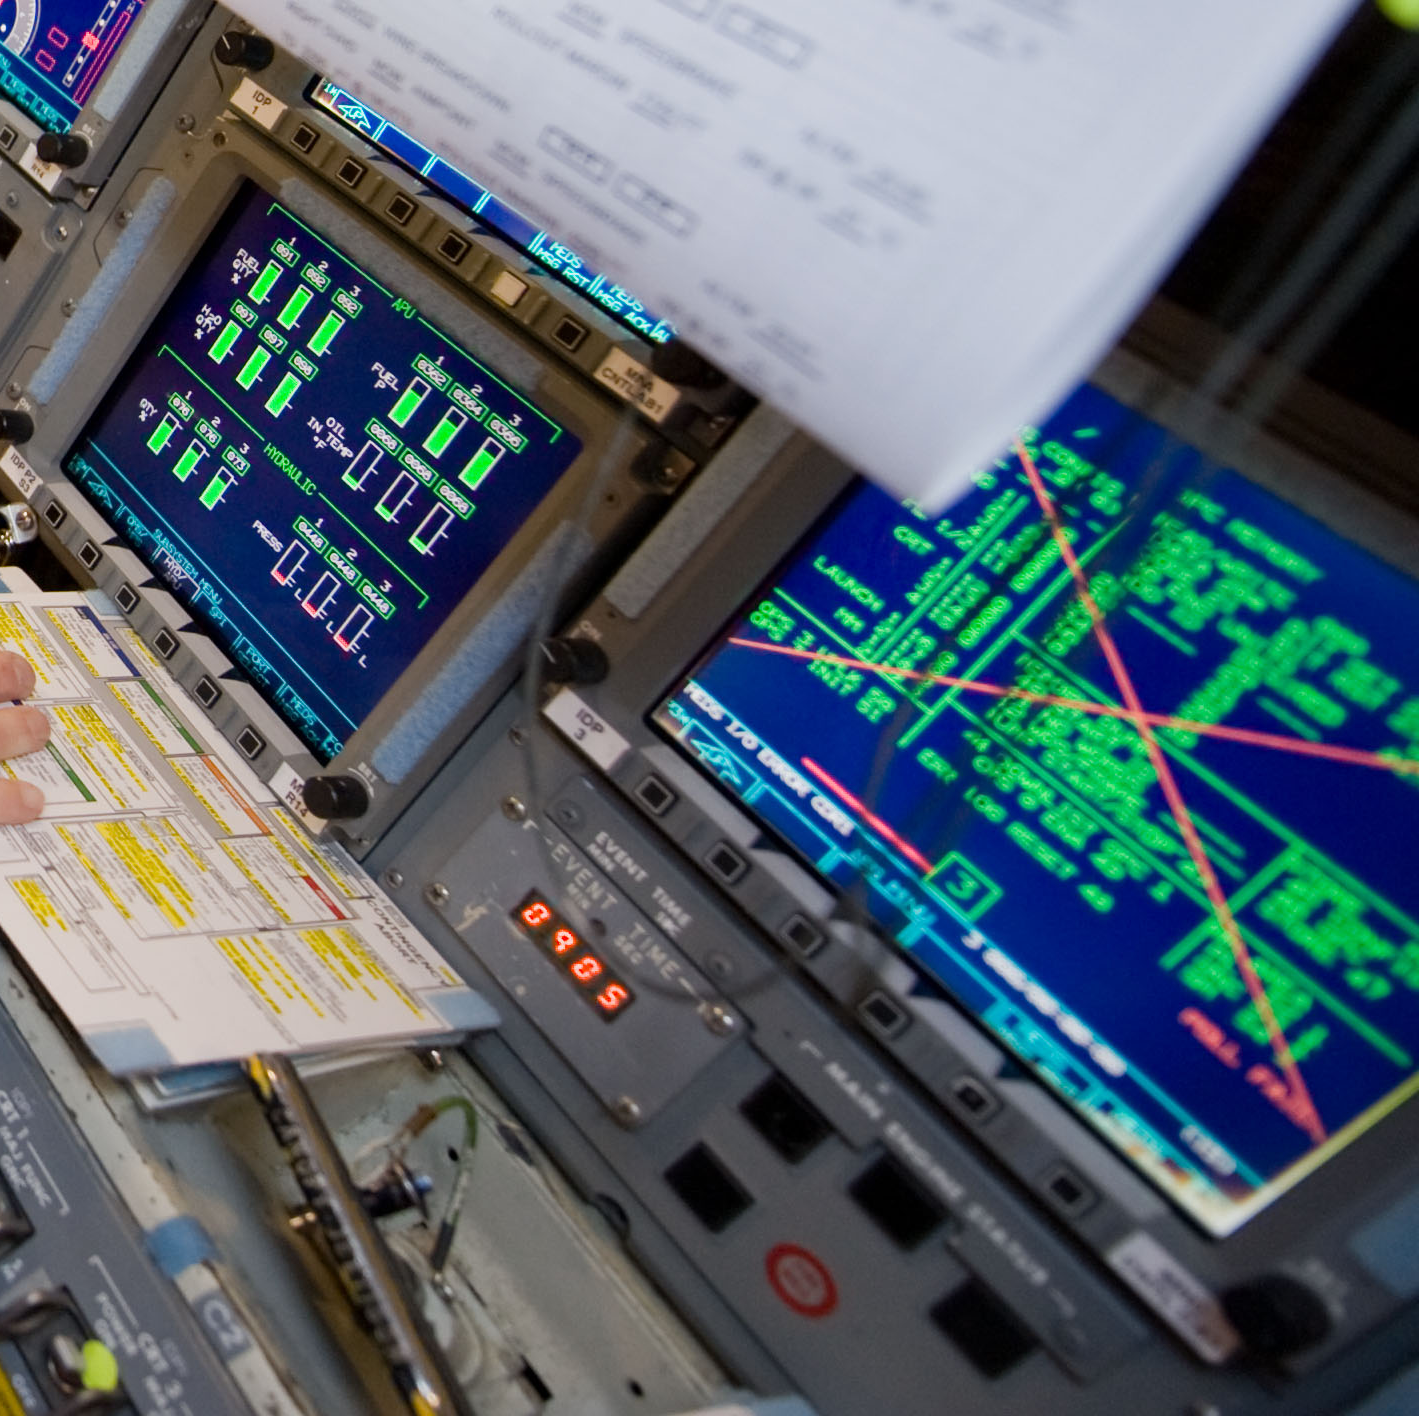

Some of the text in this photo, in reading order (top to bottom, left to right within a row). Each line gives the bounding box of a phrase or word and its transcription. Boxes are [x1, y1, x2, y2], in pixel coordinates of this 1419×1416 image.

[252, 90, 272, 106] IDP
[252, 106, 258, 114] 1
[289, 237, 297, 246] 1
[236, 248, 259, 273] FUEL
[549, 241, 585, 268] MEDS
[232, 259, 252, 278] QTY
[319, 261, 329, 272] 2
[563, 267, 591, 288] RST
[350, 285, 362, 297] 3
[201, 304, 222, 326] H2O
[391, 298, 417, 319] APU
[195, 315, 216, 334] QTY
[623, 312, 653, 333] ACK
[436, 356, 445, 366] 1
[371, 362, 399, 391] FUEL
[373, 379, 386, 389] P
[185, 390, 193, 401] 1
[470, 384, 483, 397] 2
[139, 398, 158, 418] QTY
[211, 416, 222, 428] 2
[325, 416, 345, 440] OIL
[509, 414, 523, 427] 3
[307, 416, 353, 458] IN TEMP
[239, 442, 251, 455] 3
[10, 452, 36, 484] IDP P2
[263, 442, 317, 496] HYDRAULIC
[18, 478, 30, 493] S3
[315, 518, 324, 528] 1
[252, 520, 284, 553] PRESS
[346, 548, 358, 561] 2
[154, 528, 223, 605] SUBSYSTEM MENU
[164, 555, 188, 580] HYD/
[380, 580, 393, 593] 3
[813, 554, 886, 613] LAUNCH
[209, 606, 226, 627] SPI
[246, 646, 271, 673] PORT
[290, 696, 316, 725] MEDS
[575, 708, 605, 733] IDP
[574, 728, 586, 741] 3
[682, 681, 813, 799] MEDS I/O ERROR
[594, 831, 693, 927] EVENT TIME
[944, 867, 978, 900] 3
[551, 843, 681, 980] EVENT TIME
[367, 899, 451, 987] CONTINGENCY
[375, 923, 419, 965] ABORT
[14, 1125, 30, 1140] 1
[824, 1061, 1050, 1286] MAIN ENGINE STATUS
[17, 1161, 52, 1208] FUNC
[197, 1293, 247, 1352] C2
